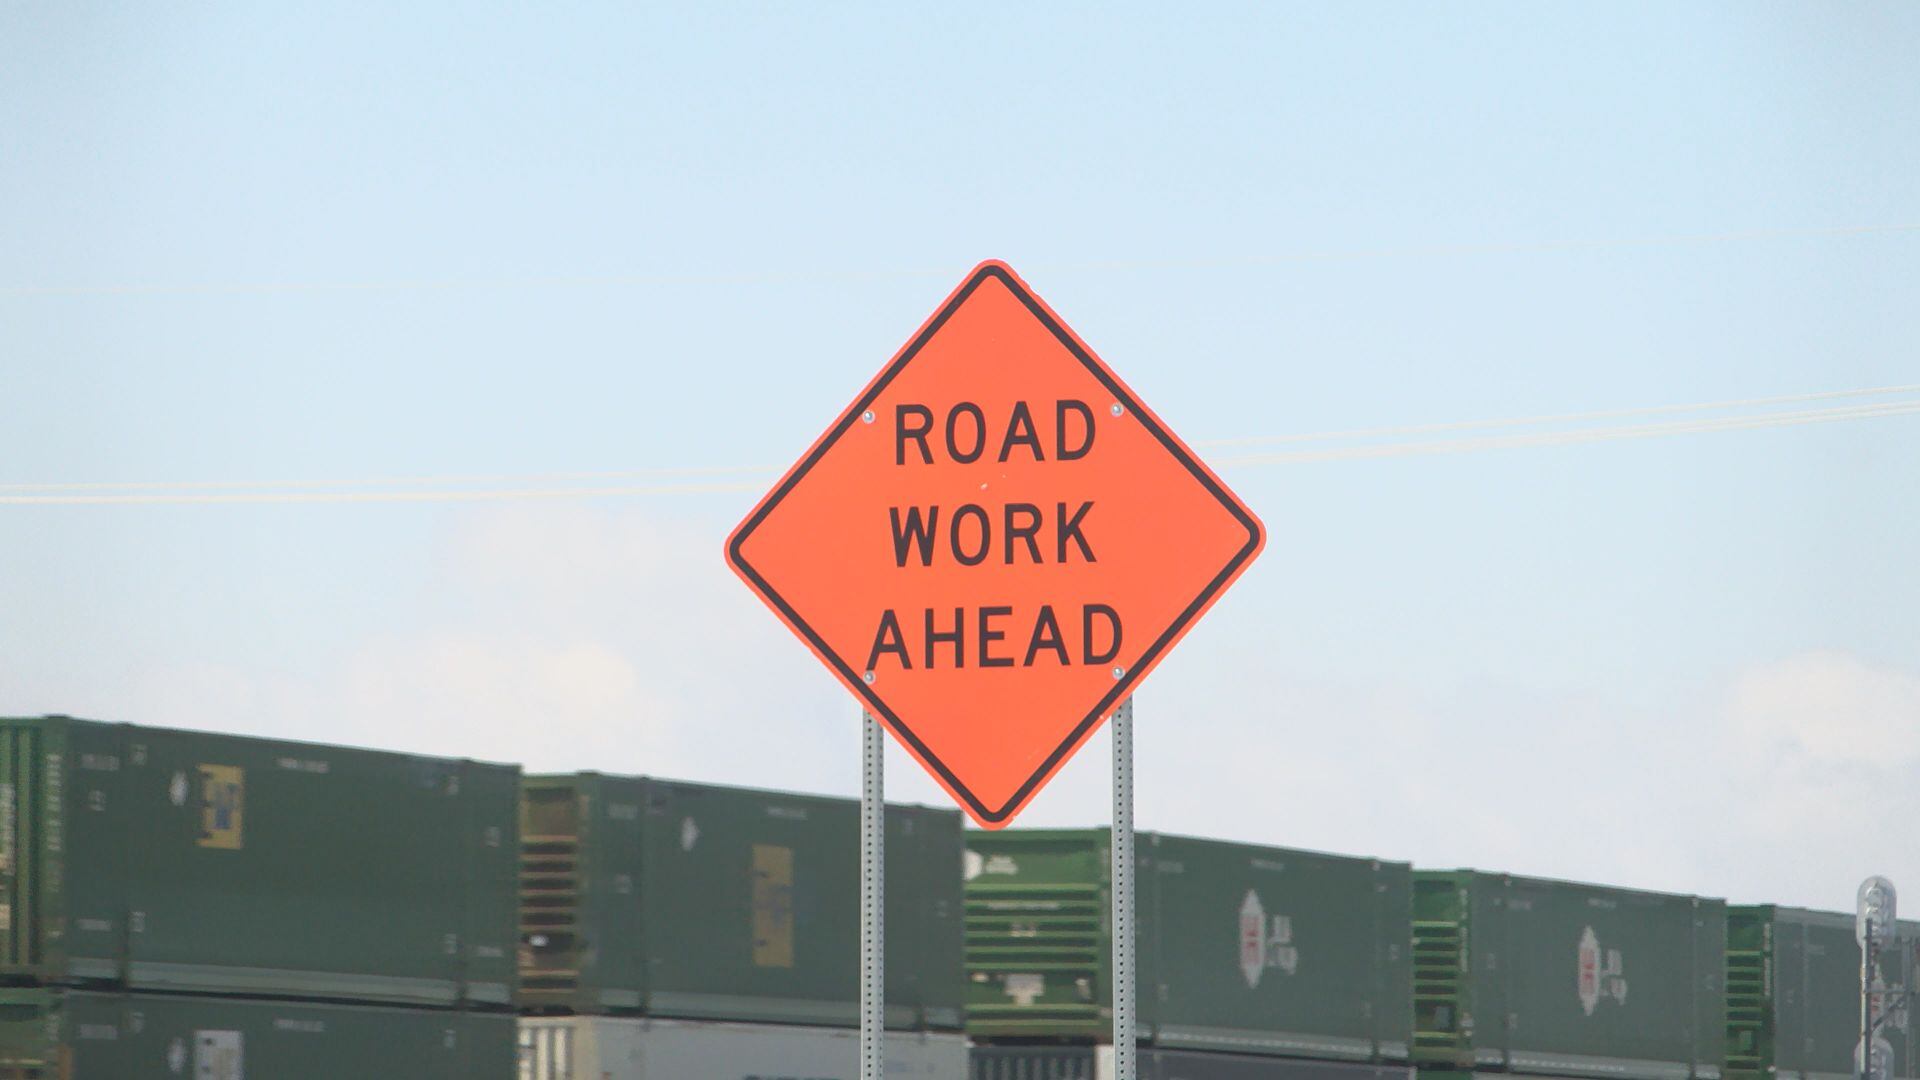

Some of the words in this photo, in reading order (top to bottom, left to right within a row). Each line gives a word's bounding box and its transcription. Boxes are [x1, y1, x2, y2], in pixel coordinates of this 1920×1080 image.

[896, 399, 1095, 465] ROAD
[889, 501, 1096, 567] WORK
[866, 604, 1123, 672] AHEAD
